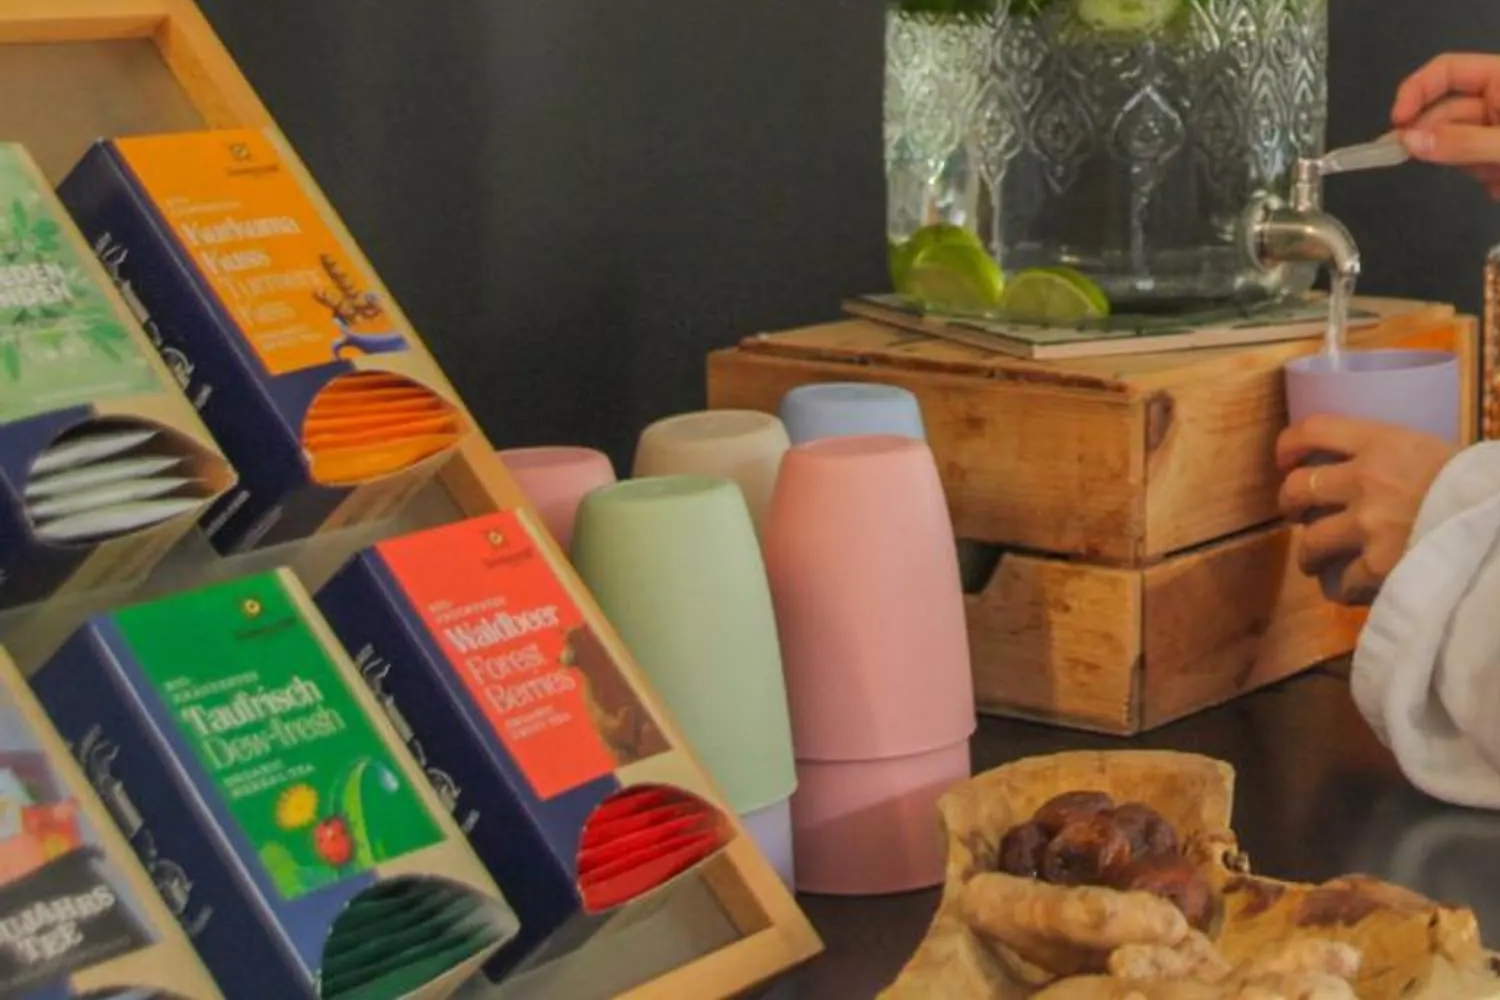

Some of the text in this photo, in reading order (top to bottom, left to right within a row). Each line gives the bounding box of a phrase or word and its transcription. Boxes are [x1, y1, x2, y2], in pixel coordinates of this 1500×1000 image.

[443, 603, 559, 656] Waldbeer
[465, 642, 545, 686] Forest
[181, 675, 324, 736] Taufrisch
[484, 673, 577, 716] Berries
[204, 704, 347, 771] Dew-fresh
